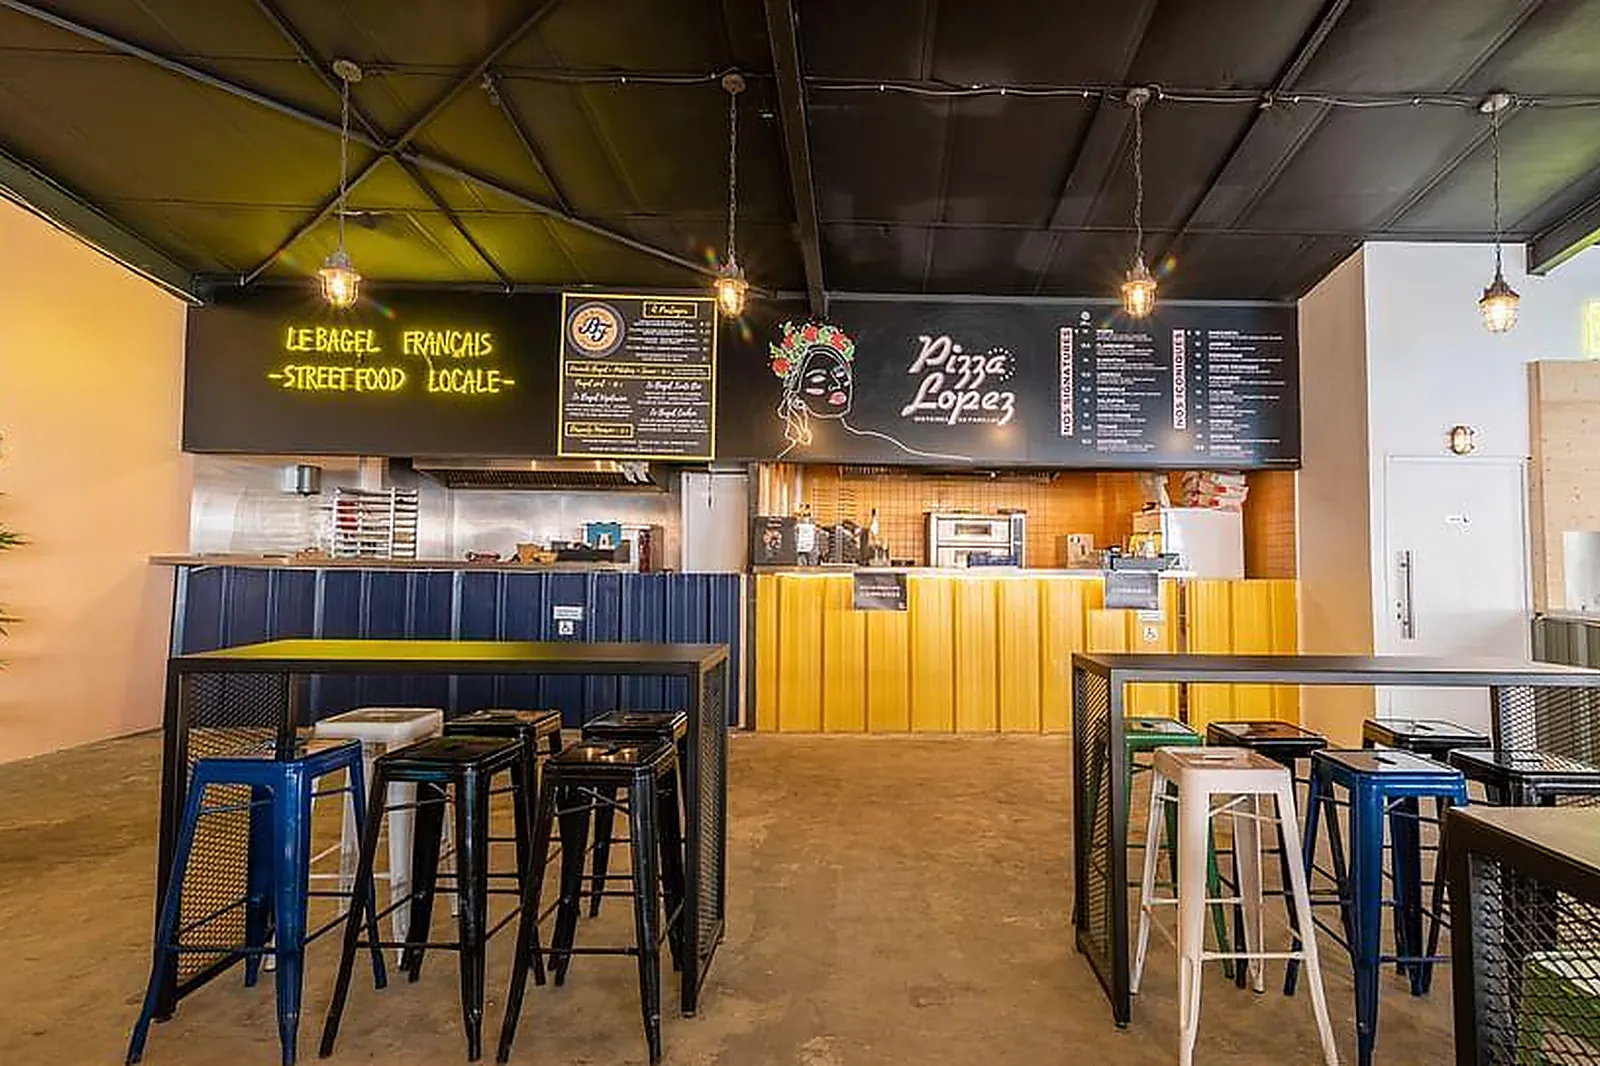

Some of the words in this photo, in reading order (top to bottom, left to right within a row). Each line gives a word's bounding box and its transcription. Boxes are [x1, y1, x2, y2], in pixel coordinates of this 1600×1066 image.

[355, 366, 406, 392] FOOD
[908, 335, 1006, 390] Pizza
[1063, 329, 1071, 405] SIGNATURES
[1175, 332, 1184, 399] ICONIQUES
[901, 372, 1015, 425] Lopez
[1063, 407, 1071, 433] NOS
[1176, 402, 1184, 427] NOS
